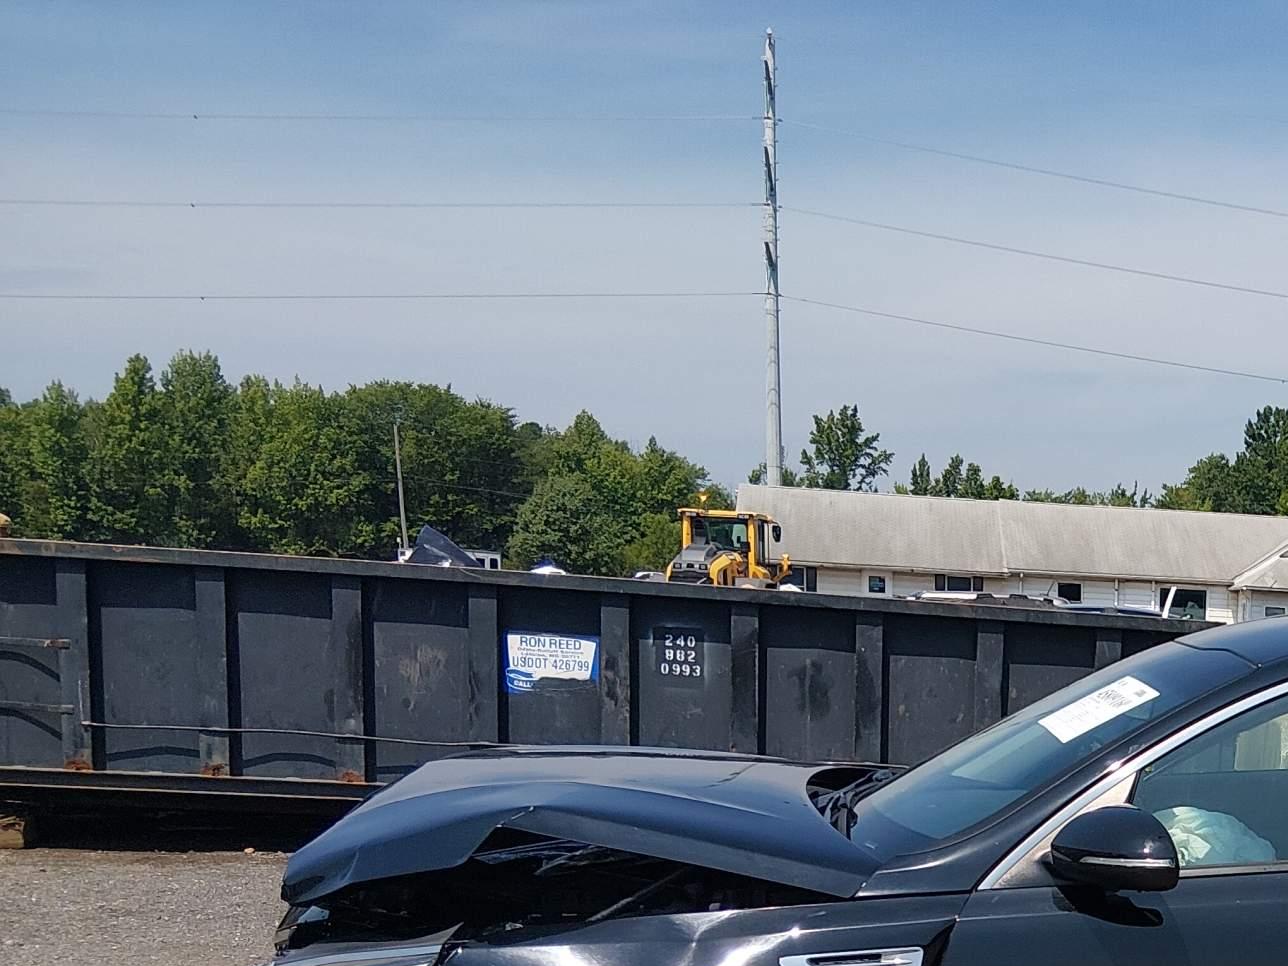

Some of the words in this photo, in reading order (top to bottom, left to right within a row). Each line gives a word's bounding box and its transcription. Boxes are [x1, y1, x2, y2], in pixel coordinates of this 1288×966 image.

[520, 636, 546, 649] RON
[549, 638, 582, 650] REED
[665, 634, 696, 647] 240
[665, 649, 696, 662] 882
[512, 656, 548, 669] USDOT
[552, 658, 590, 672] 426799
[660, 663, 701, 677] 0993
